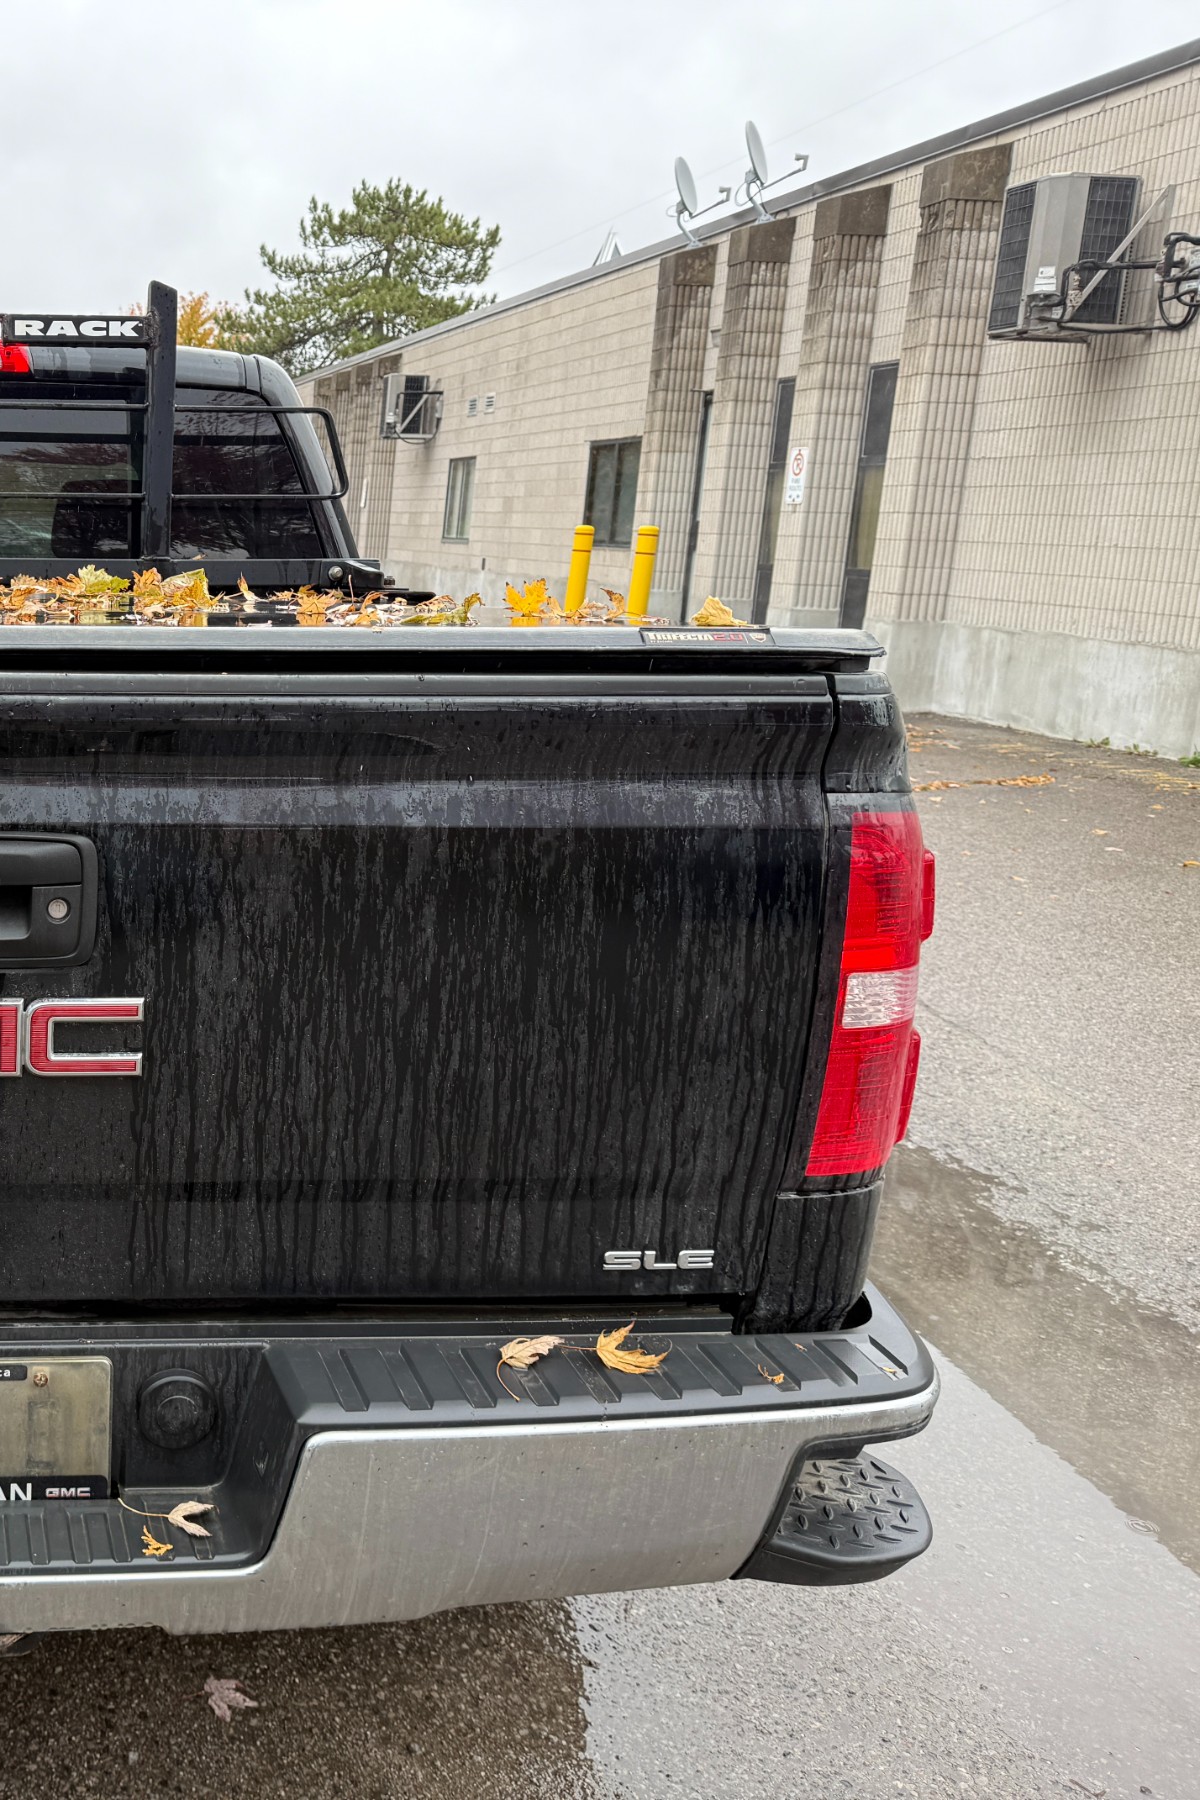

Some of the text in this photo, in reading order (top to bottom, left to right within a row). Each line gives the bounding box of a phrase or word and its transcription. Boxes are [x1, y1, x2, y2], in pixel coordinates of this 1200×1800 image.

[14, 319, 140, 337] RACK
[603, 1249, 715, 1271] SLE
[45, 1487, 91, 1498] GMC
